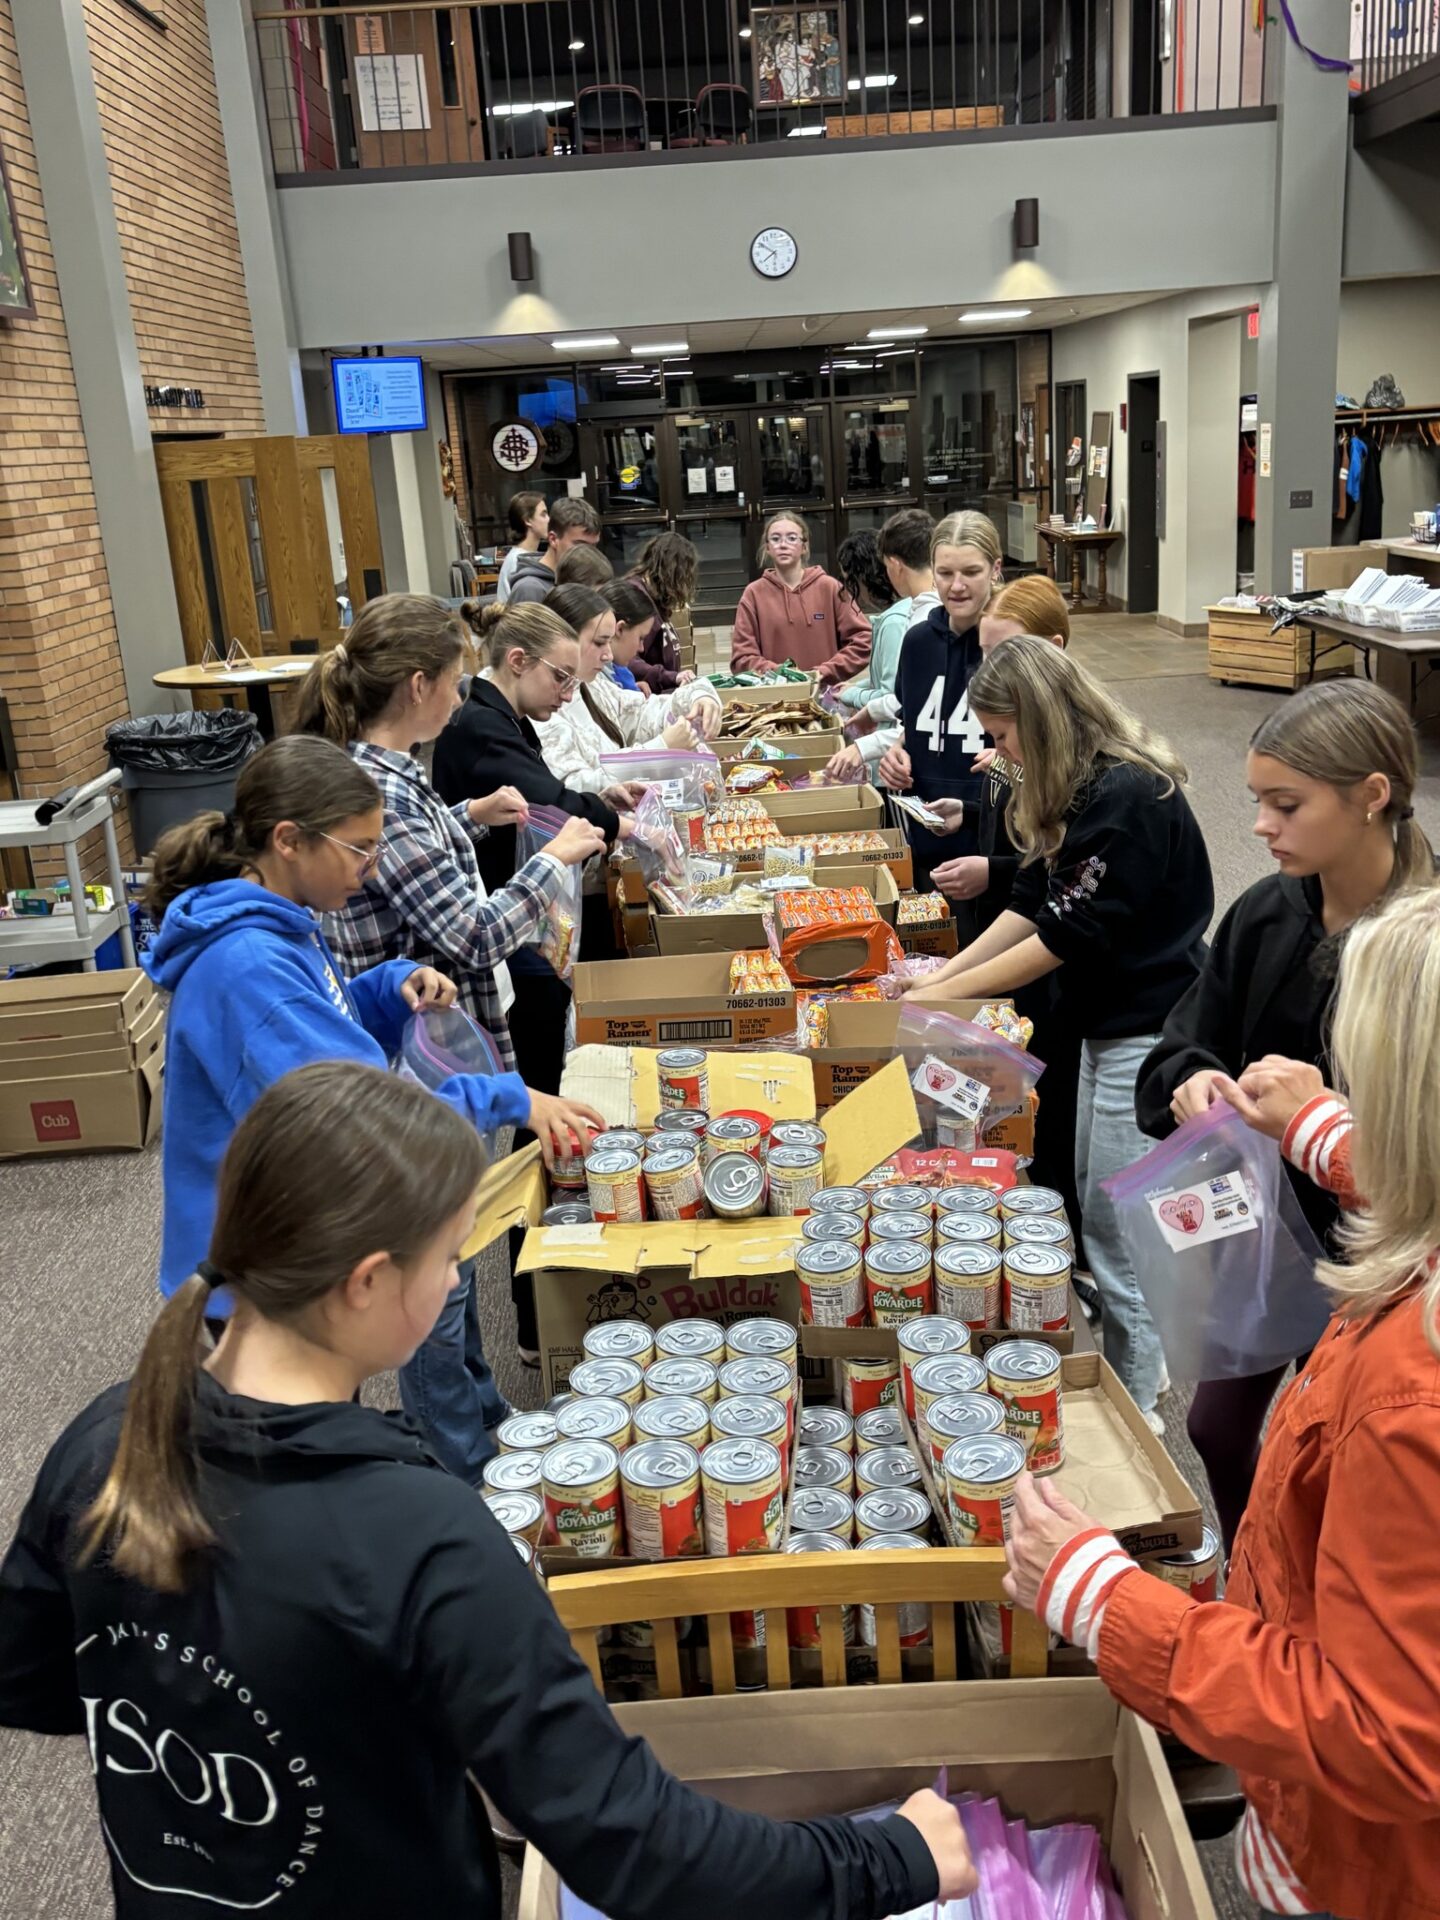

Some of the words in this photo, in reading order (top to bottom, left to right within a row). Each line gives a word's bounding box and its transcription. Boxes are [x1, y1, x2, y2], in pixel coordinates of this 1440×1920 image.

[915, 675, 985, 754] 44
[862, 851, 904, 862] 70662-01303
[725, 996, 787, 1009] 70662-01303
[606, 1020, 629, 1029] Top
[607, 1028, 650, 1039] Ramen
[830, 1064, 853, 1075] Top
[41, 1114, 71, 1129] Cub
[661, 1276, 779, 1320] Buldak
[873, 1296, 923, 1310] BOYARDEE
[556, 1506, 617, 1528] BOYARDEE
[571, 1534, 606, 1547] Ravioli
[179, 1646, 283, 1746] SCHOOL
[288, 1757, 317, 1790] OF
[163, 1832, 190, 1849] Est.
[276, 1804, 324, 1888] DANCE
